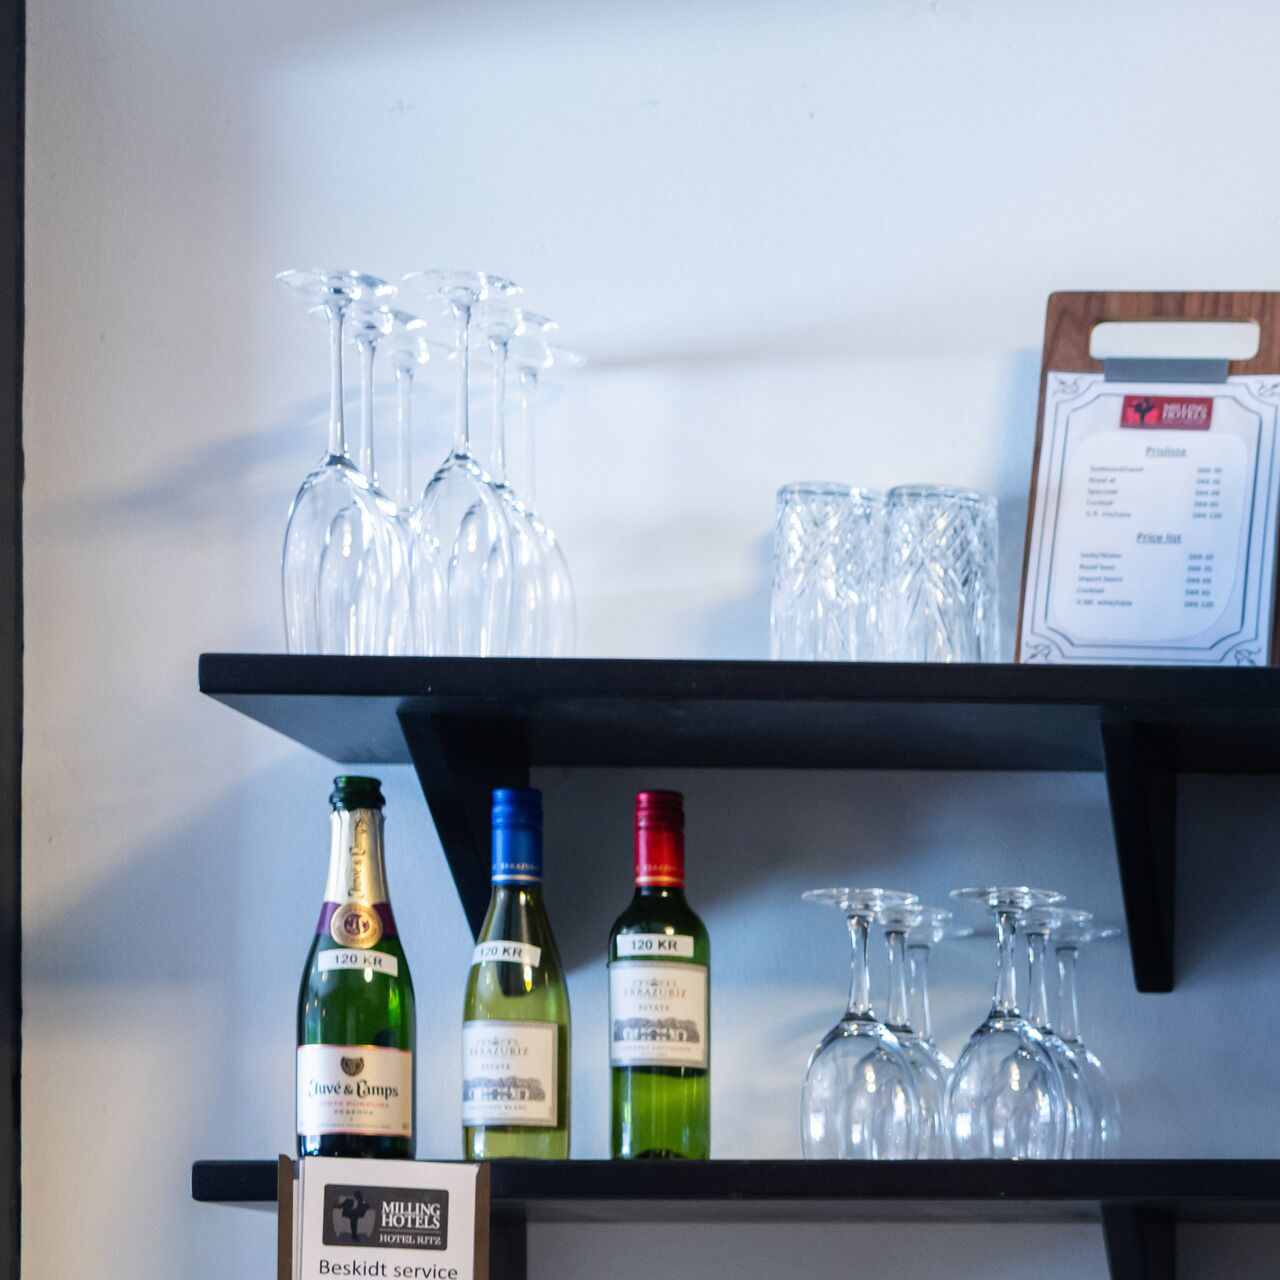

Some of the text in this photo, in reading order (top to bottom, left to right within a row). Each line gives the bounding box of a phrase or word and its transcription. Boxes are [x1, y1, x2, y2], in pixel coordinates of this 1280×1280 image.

[480, 947, 523, 957] 120 KR
[632, 940, 678, 951] 120 KR
[334, 953, 383, 966] 120 KR
[382, 1200, 441, 1216] MILLING
[381, 1214, 440, 1229] HOTELS
[380, 1233, 441, 1246] HOTEL RITZ
[319, 1259, 458, 1280] Beskidt service
